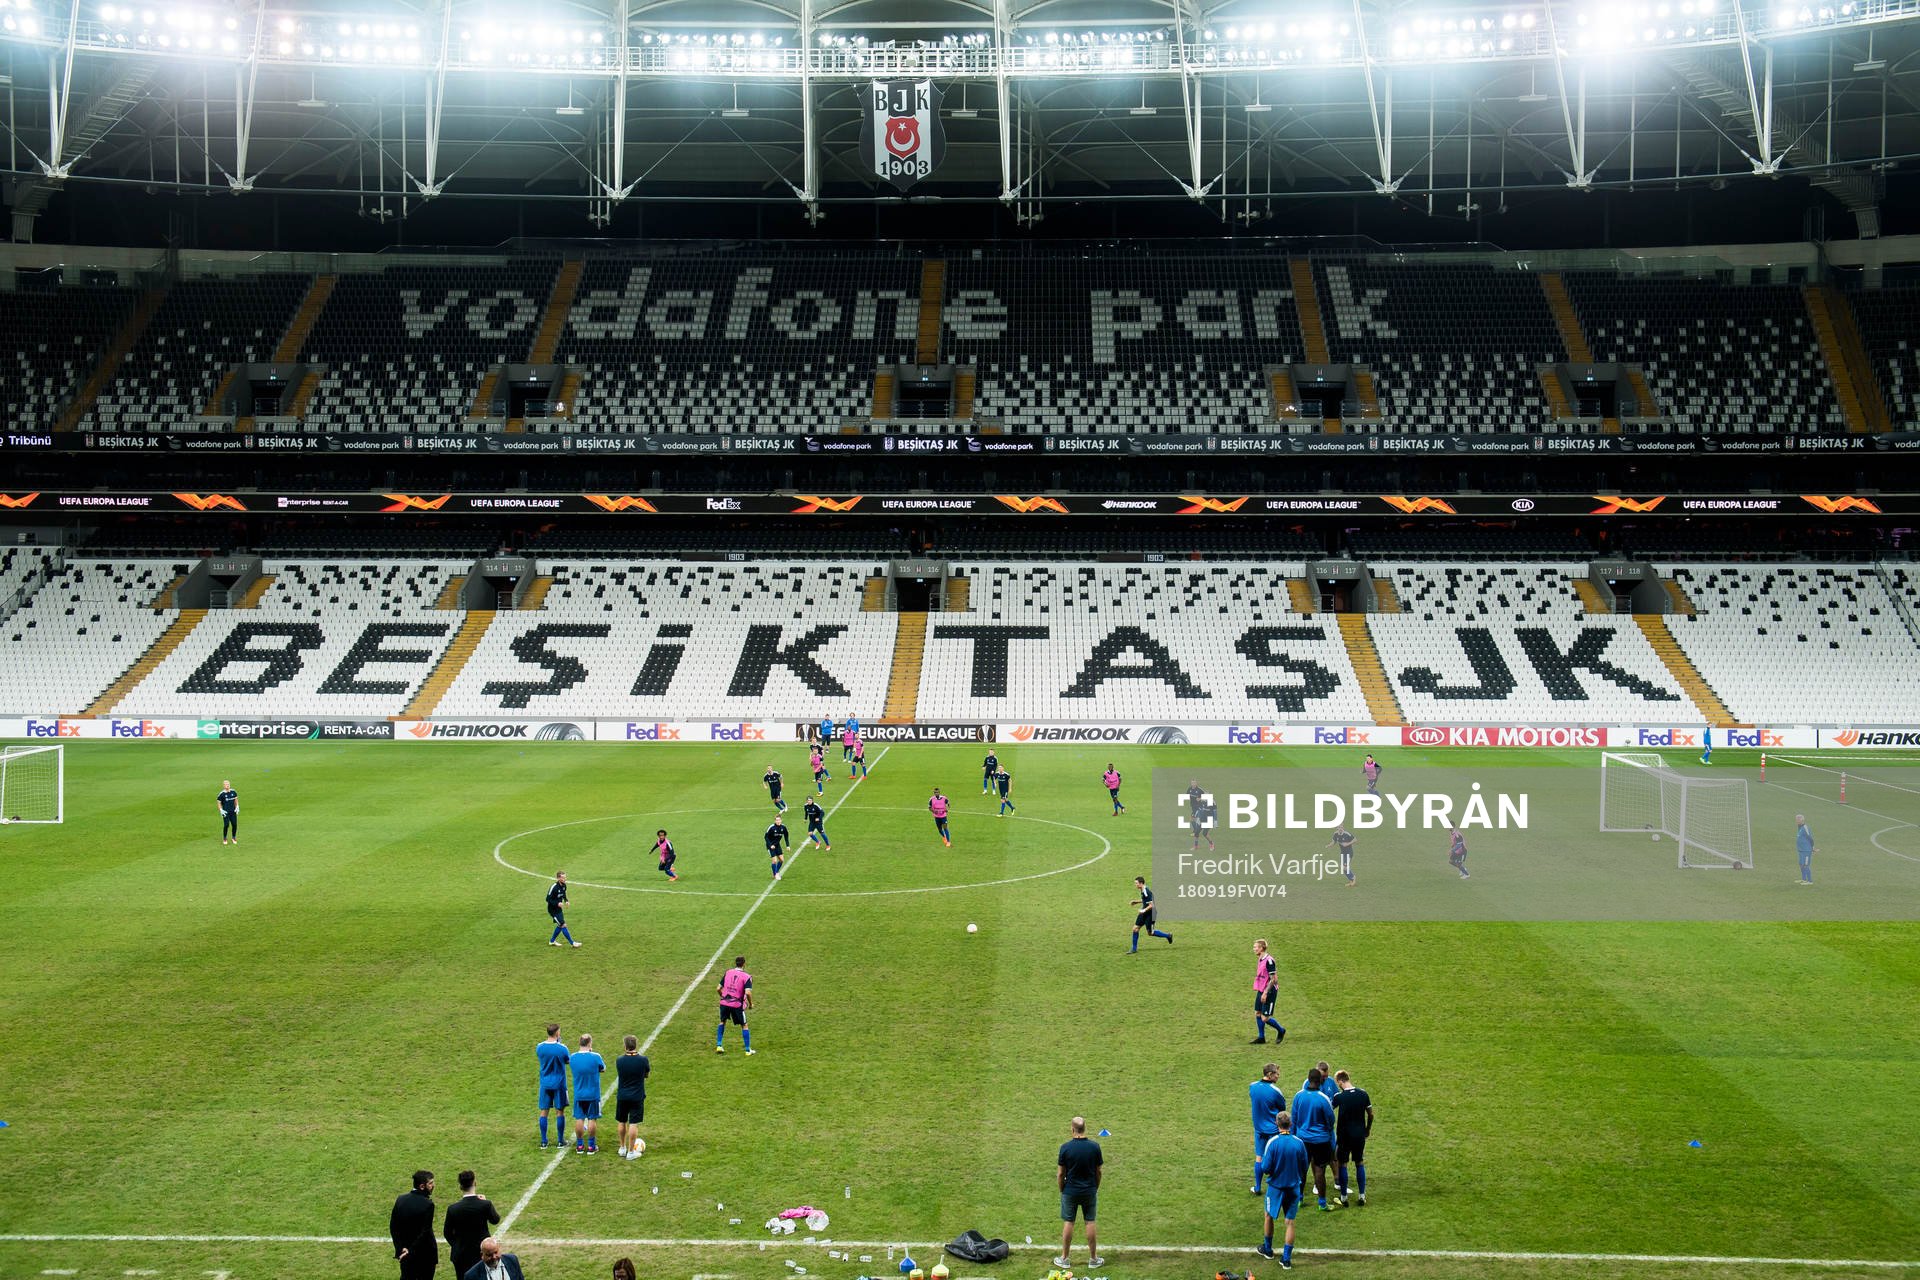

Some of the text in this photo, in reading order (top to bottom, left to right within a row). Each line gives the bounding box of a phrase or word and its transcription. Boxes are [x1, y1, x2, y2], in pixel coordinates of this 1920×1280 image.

[880, 161, 929, 176] 1903
[400, 266, 1398, 363] vodafone park
[9, 436, 51, 445] Tribünü
[99, 436, 159, 448] BEŞİKTAŞ JK
[186, 440, 241, 449] vodafone park
[258, 437, 317, 449] BEŞİKTAŞ JK
[344, 441, 399, 450] vodafone park
[417, 438, 477, 450] BEŞİKTAŞ JK
[504, 441, 558, 450] vodafone park
[576, 438, 635, 450] BEŞİKTAŞ JK
[700, 442, 717, 450] park
[735, 438, 794, 450] BEŞİKTAŞ JK
[856, 442, 871, 450] park
[898, 438, 958, 451] BEŞİKTAŞ JK
[1059, 438, 1119, 451] BEŞİKTAŞ JK
[1185, 442, 1203, 451] park
[1221, 438, 1282, 451] BEŞİKTAŞ JK
[1308, 442, 1364, 451] vodafone park
[1383, 438, 1444, 451] BEŞİKTAŞ JK
[1472, 442, 1529, 451] vodafone park
[1548, 438, 1610, 451] BEŞİKTAŞ JK
[1637, 441, 1695, 450] vodafone park
[1722, 441, 1780, 450] vodafone park
[1800, 437, 1864, 450] BEŞİKTAŞ JK
[1017, 443, 1033, 451] park
[707, 498, 740, 509] FedEx
[1148, 554, 1164, 562] 1903
[1398, 627, 1681, 701] JK
[27, 720, 80, 736] FedEx
[112, 720, 164, 736] FedEx
[203, 723, 390, 738] enterprise RENT-A-CAR
[627, 724, 680, 740] FedEx
[711, 724, 764, 740] FedEx
[860, 728, 916, 740] EUROPA
[919, 728, 977, 740] LEAGUE
[1229, 727, 1283, 743] FedEx
[1315, 728, 1369, 744] FedEx
[1415, 728, 1604, 746] KIA KIA MOTORS
[1639, 729, 1694, 746] FedEx
[1728, 730, 1784, 746] FedEx
